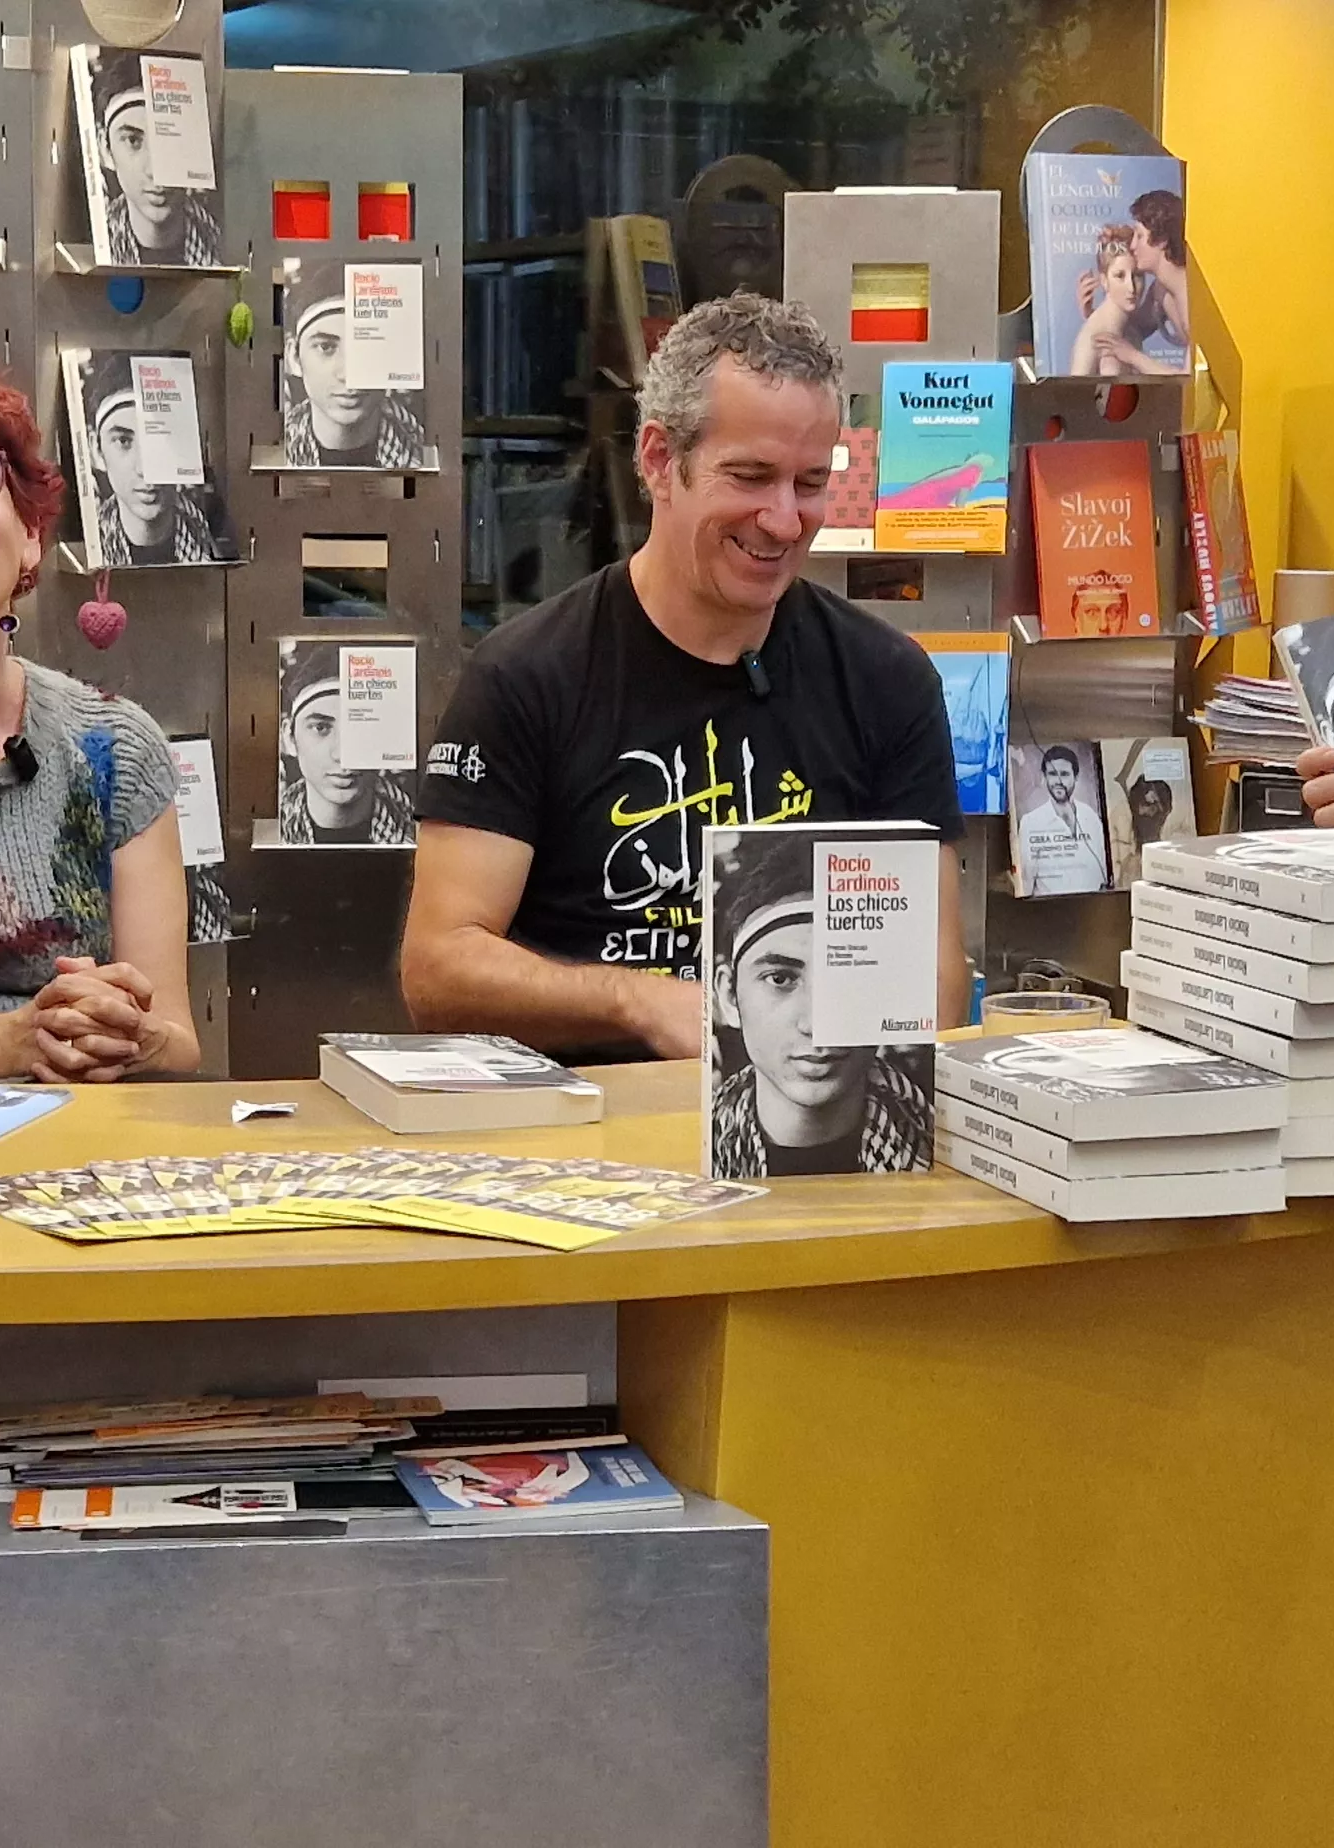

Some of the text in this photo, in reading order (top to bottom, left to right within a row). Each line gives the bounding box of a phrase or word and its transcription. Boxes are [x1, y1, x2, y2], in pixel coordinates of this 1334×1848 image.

[1051, 203, 1112, 218] OCULTO
[924, 371, 970, 389] Kurt
[900, 391, 994, 413] Vonnegut
[1061, 491, 1132, 519] Slavoj
[1105, 573, 1133, 584] LOCO
[827, 853, 871, 872] Rocío
[827, 873, 900, 893] Lardinois
[827, 894, 908, 912] Los chicos
[827, 913, 884, 932] tuertos
[881, 1018, 919, 1031] Alianza
